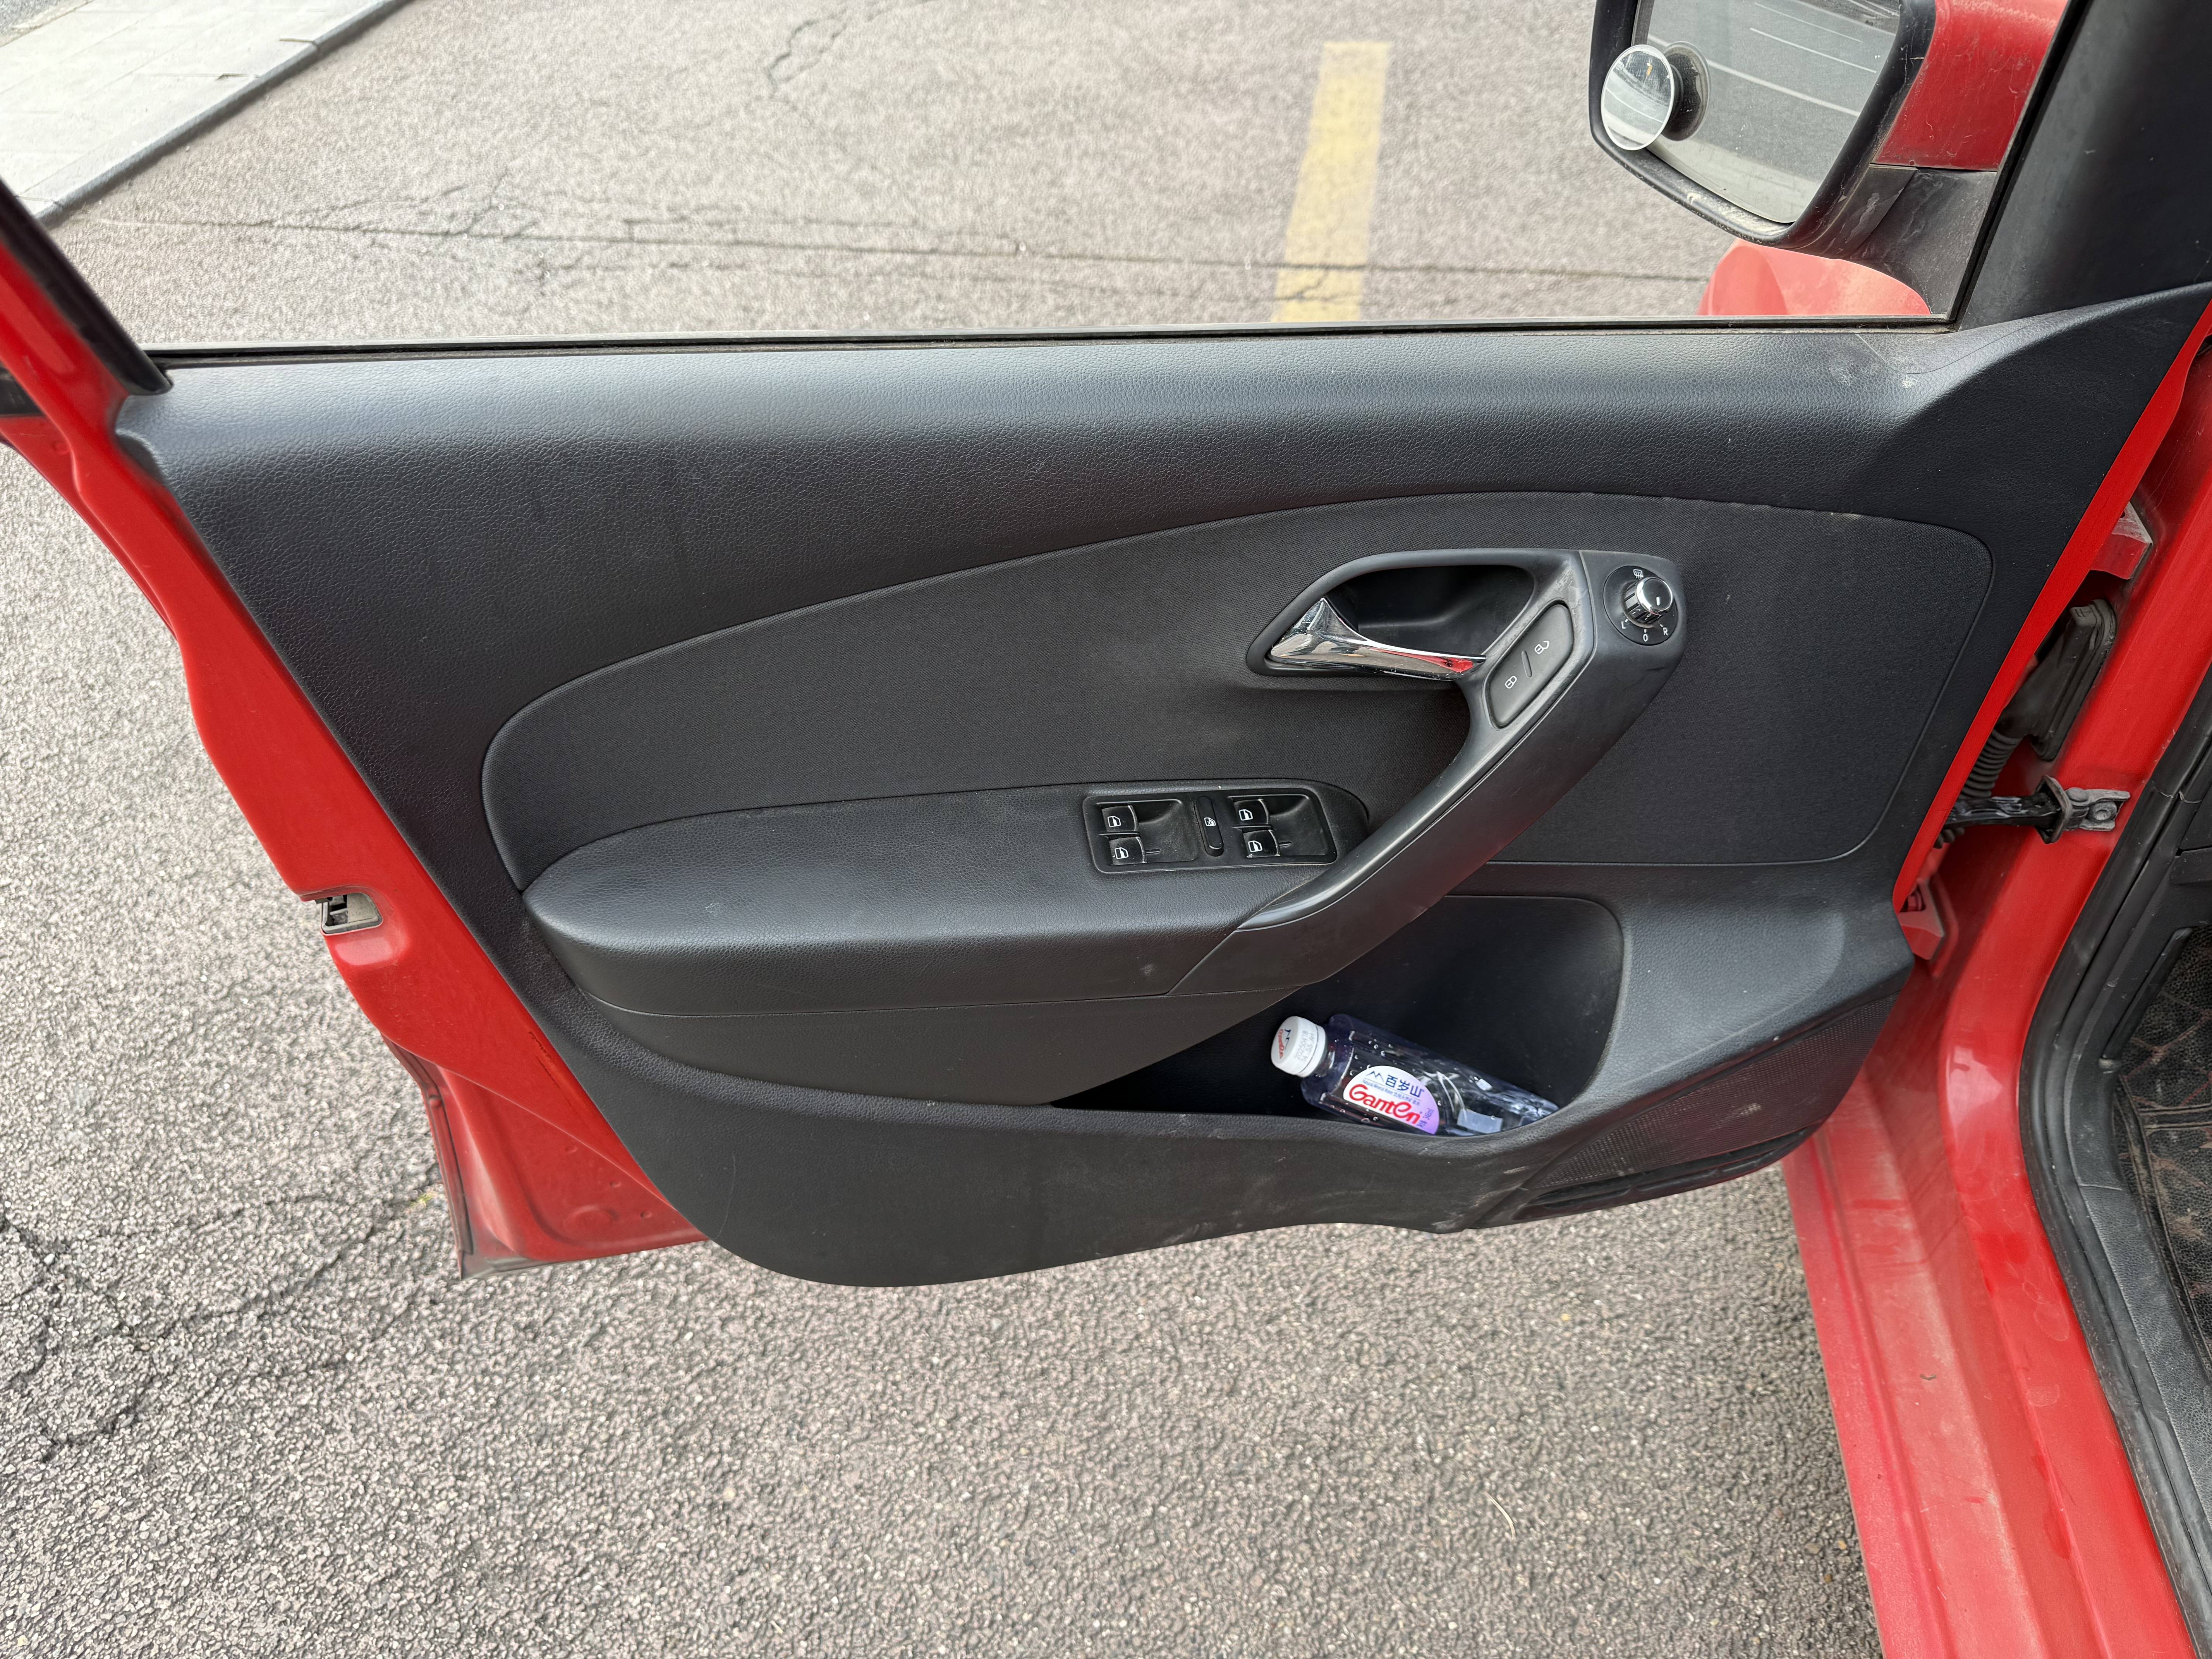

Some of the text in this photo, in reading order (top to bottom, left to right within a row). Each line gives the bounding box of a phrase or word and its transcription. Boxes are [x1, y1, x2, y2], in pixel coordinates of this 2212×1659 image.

[1663, 627, 1668, 636] R
[1385, 1074, 1422, 1098] 百岁山
